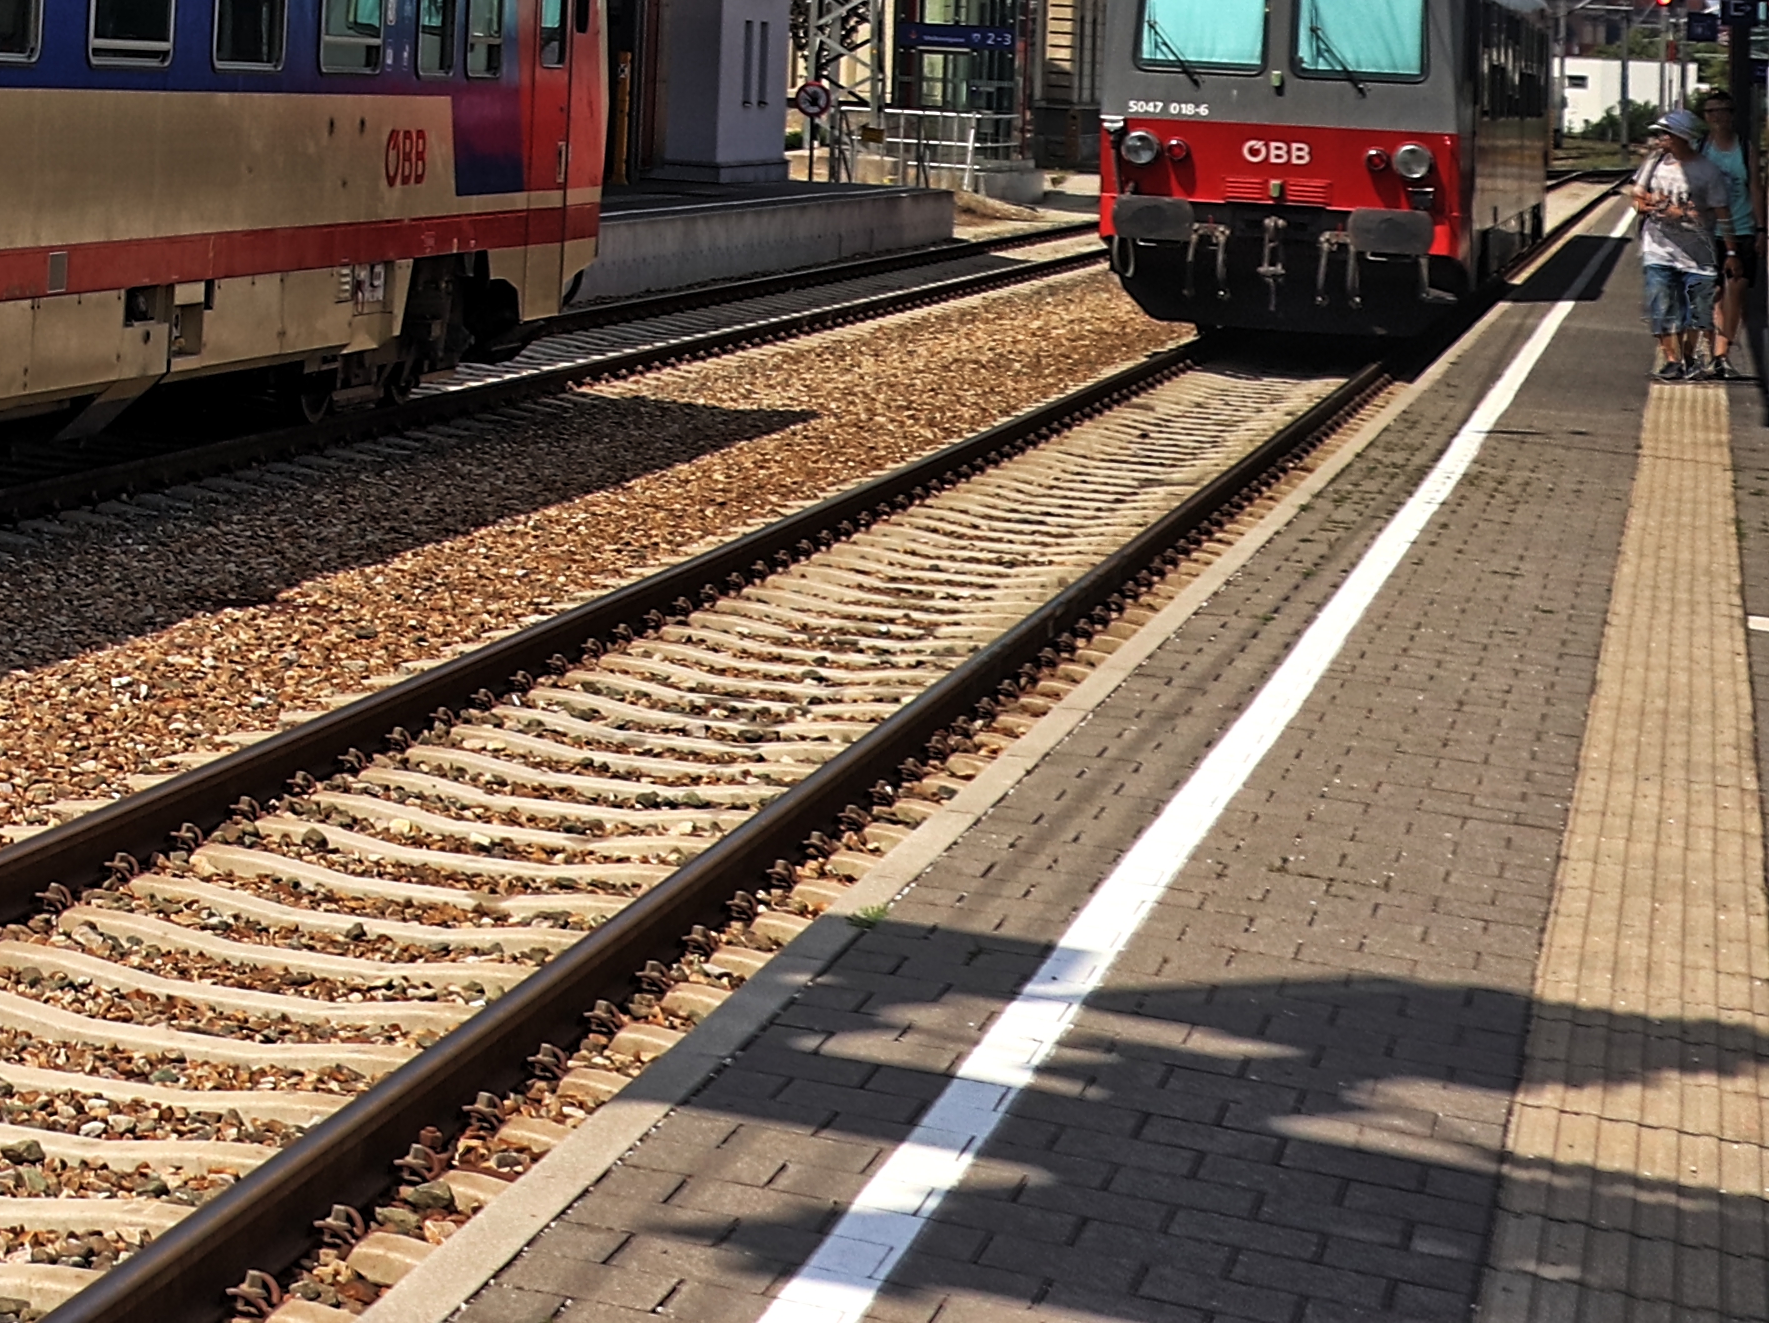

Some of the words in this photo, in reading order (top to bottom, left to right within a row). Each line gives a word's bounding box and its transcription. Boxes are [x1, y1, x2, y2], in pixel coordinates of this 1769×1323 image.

[986, 32, 1012, 46] 2-3
[1127, 100, 1163, 113] 5047
[1168, 102, 1210, 116] 018-6
[384, 128, 427, 188] ÖBB
[1242, 139, 1311, 165] ÖBB
